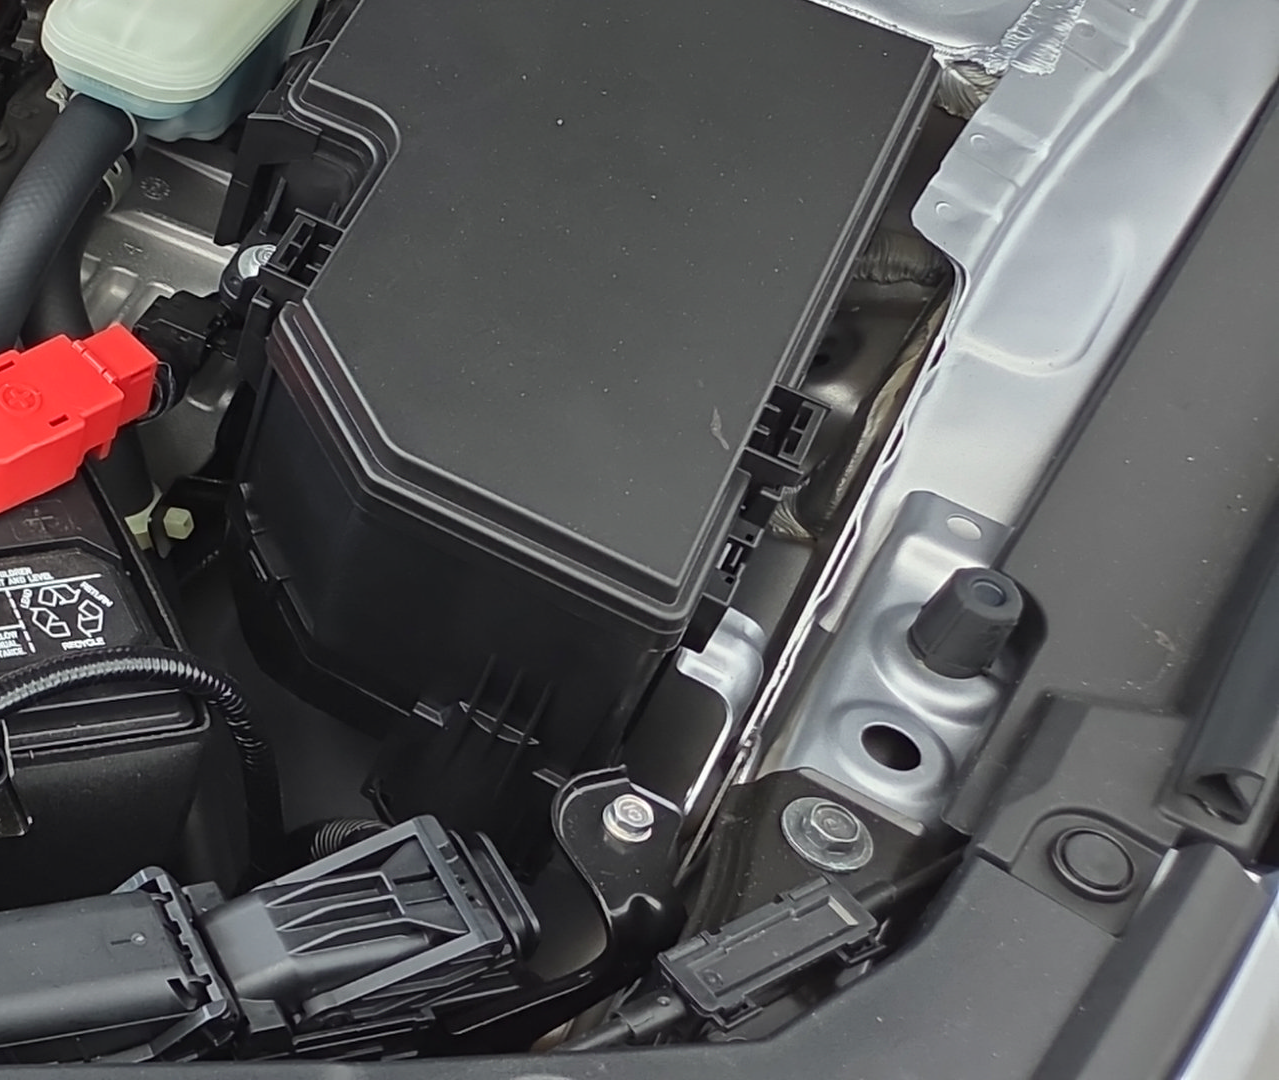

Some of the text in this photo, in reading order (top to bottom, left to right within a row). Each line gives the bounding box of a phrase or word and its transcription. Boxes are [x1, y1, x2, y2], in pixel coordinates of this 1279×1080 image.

[7, 575, 28, 585] AND
[29, 571, 55, 582] LEVEL
[20, 588, 33, 609] LEAD
[80, 581, 114, 608] RETURN
[61, 636, 106, 651] RECYCLE
